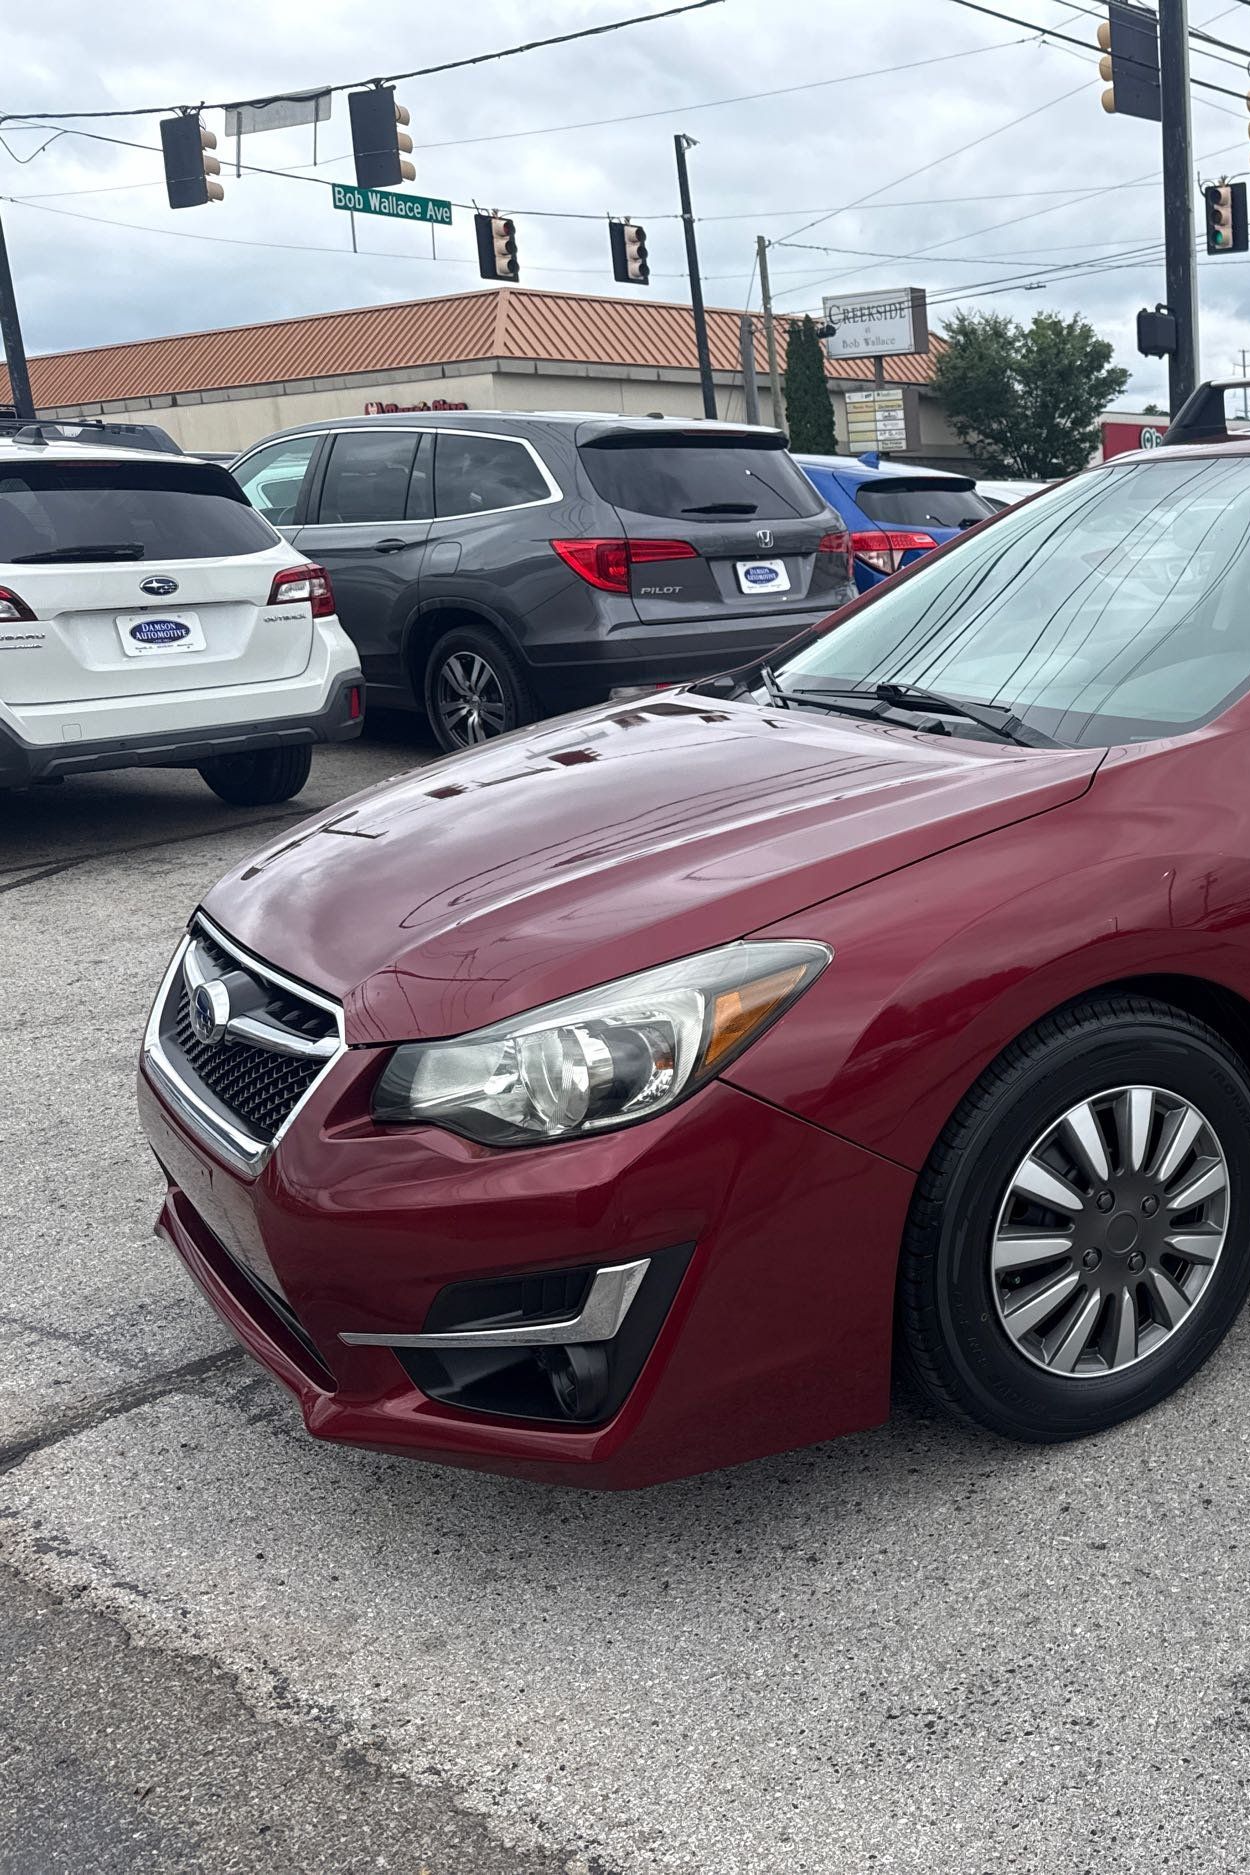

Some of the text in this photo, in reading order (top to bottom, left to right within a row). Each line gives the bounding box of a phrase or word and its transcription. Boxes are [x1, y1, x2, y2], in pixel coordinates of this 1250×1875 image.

[334, 187, 451, 222] Bob Wallace Ave
[828, 302, 906, 325] CREEKSIDE
[842, 337, 896, 349] Bob Wallace
[640, 586, 683, 595] PILOT
[142, 622, 176, 632] DAMSON
[135, 629, 187, 640] AUTOMOTIVE
